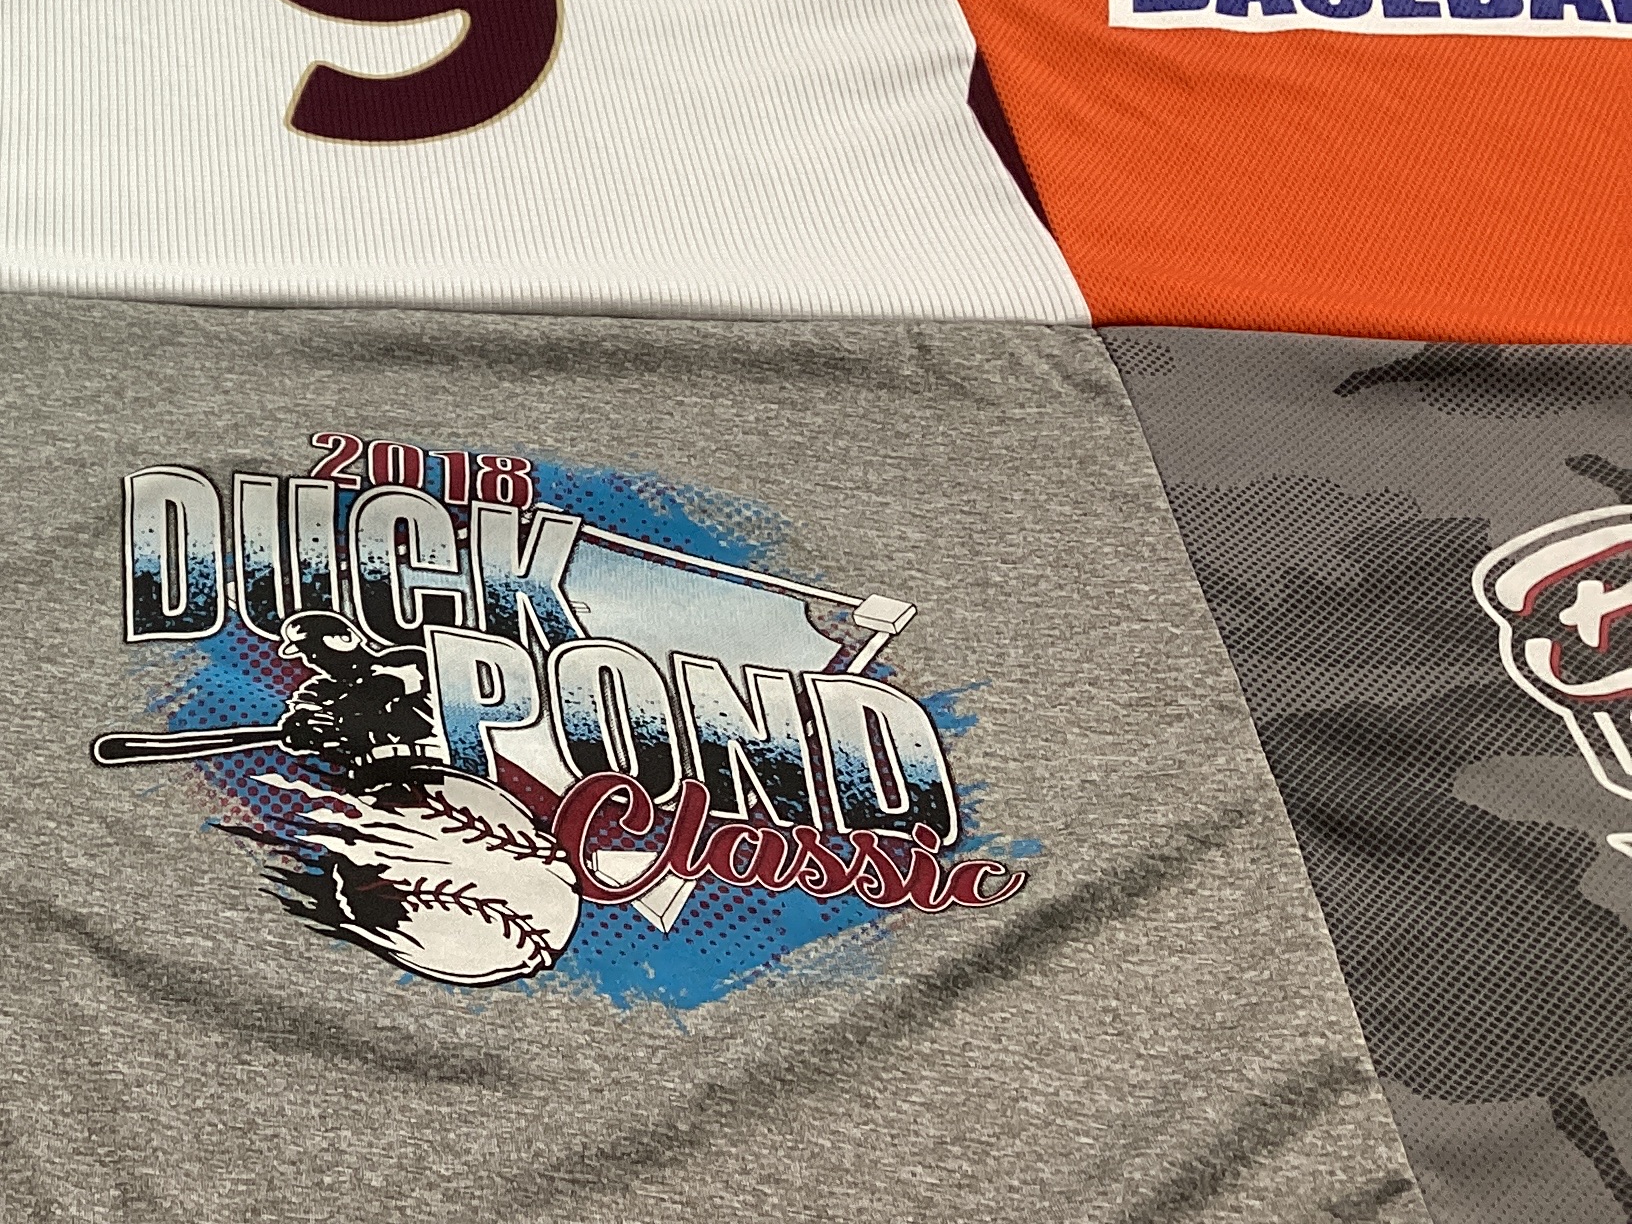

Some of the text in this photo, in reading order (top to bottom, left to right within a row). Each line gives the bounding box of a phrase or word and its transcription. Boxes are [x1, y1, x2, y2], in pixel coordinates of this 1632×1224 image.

[311, 432, 534, 512] 2018
[122, 464, 586, 644] DUCK
[423, 624, 960, 848] POND
[552, 771, 1027, 912] Classic
